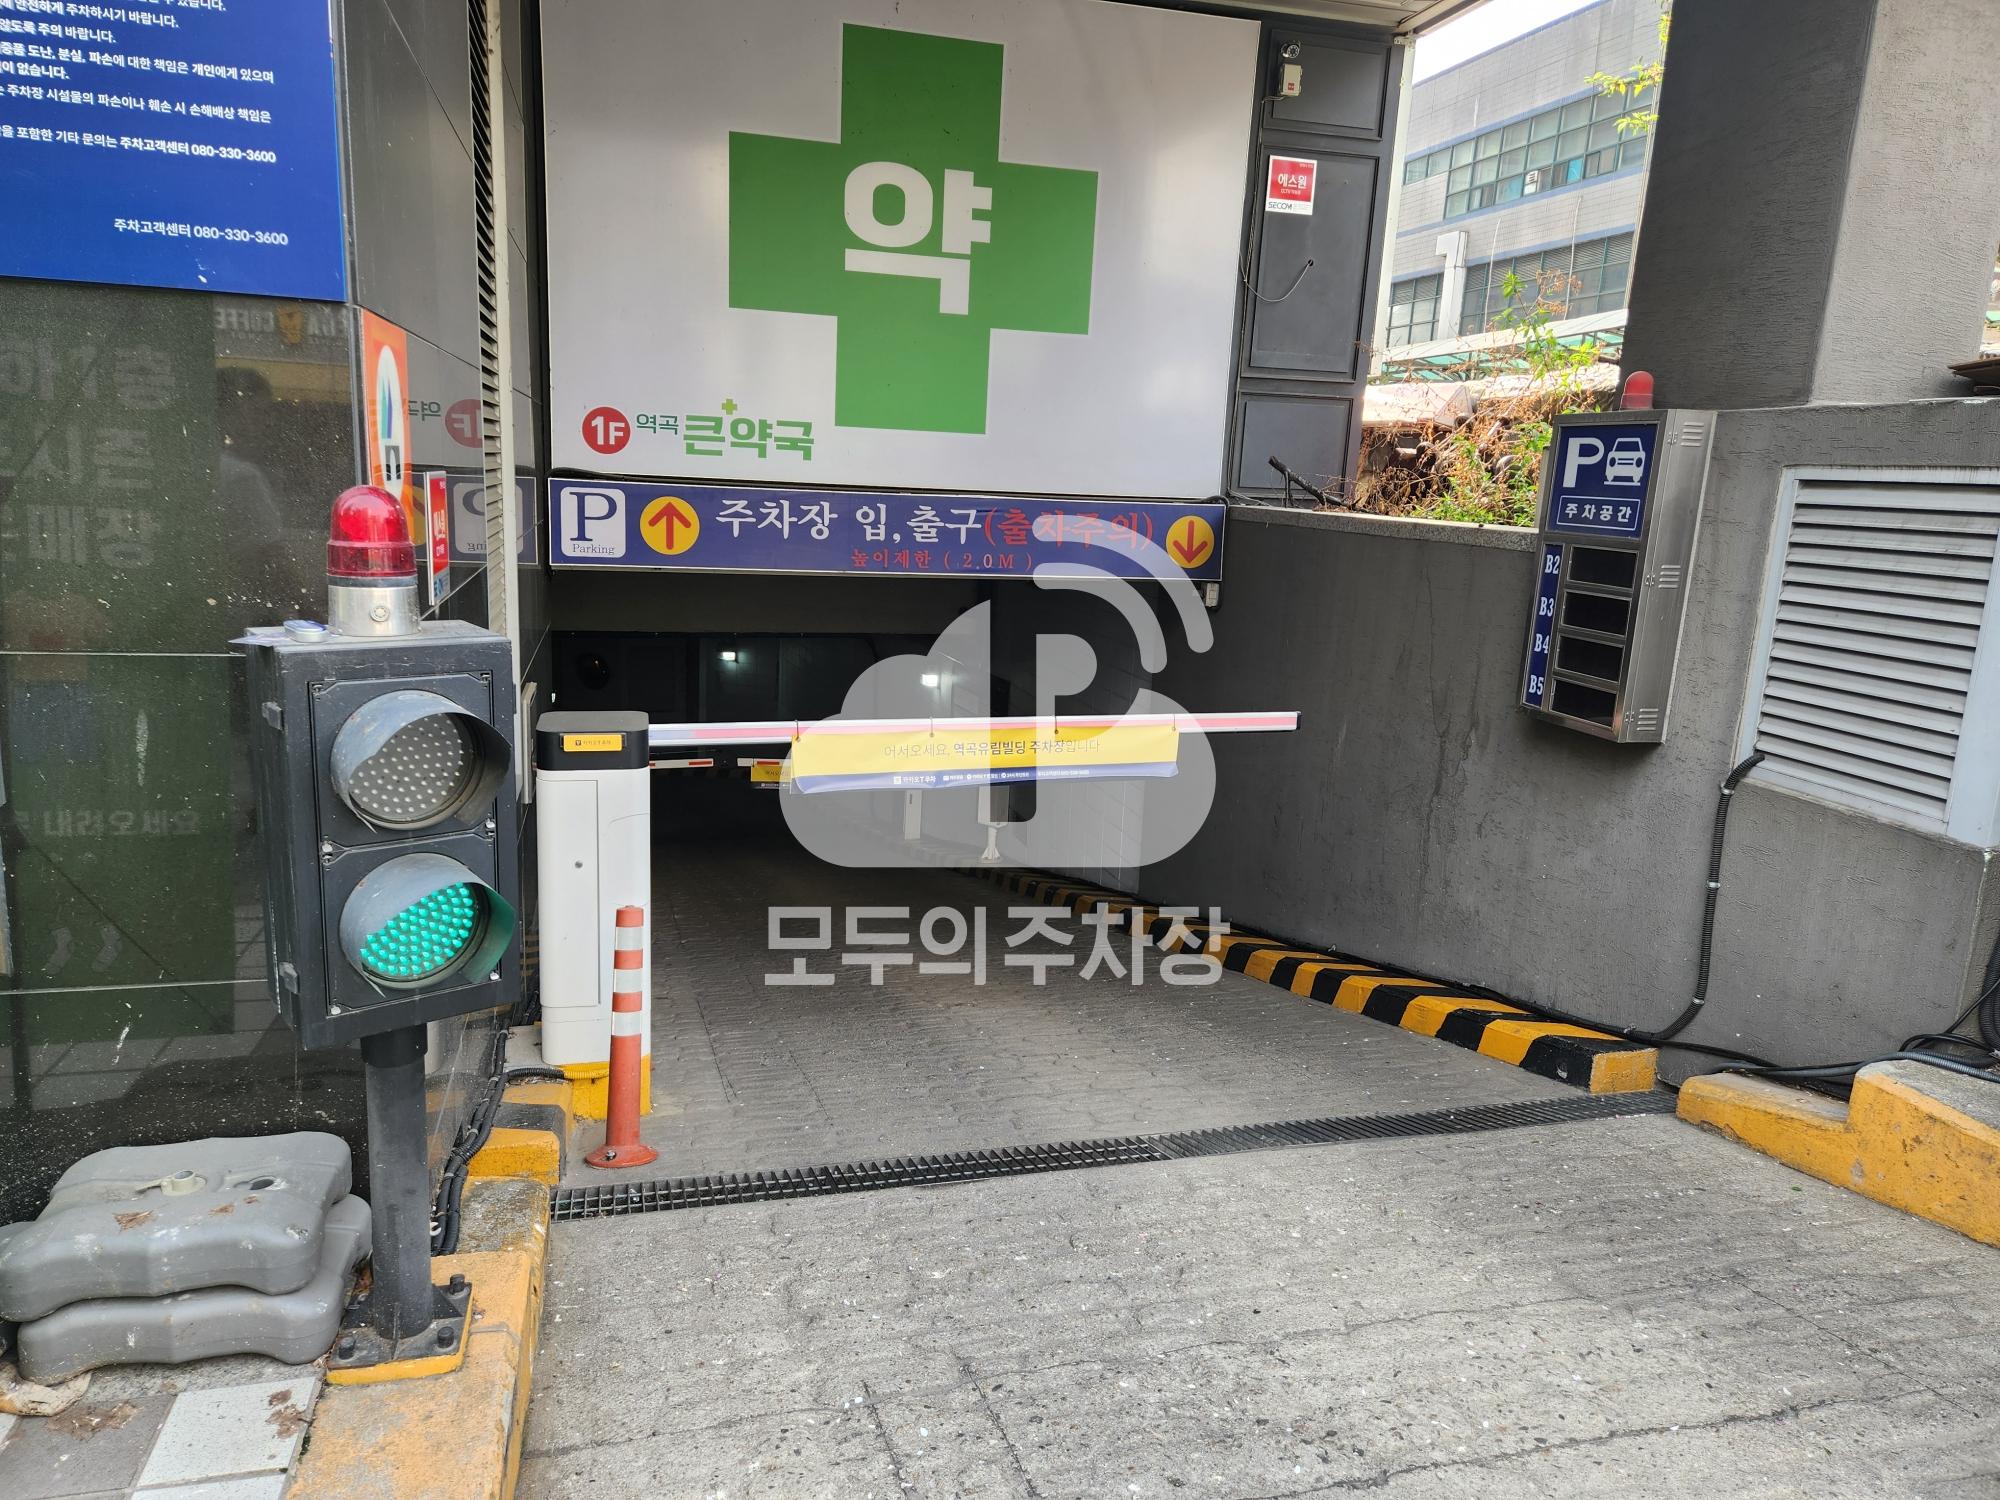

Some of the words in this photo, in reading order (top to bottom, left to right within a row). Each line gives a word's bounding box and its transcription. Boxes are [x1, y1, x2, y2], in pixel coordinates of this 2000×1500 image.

[66, 3, 126, 22] 주차하시기
[128, 10, 179, 28] 바랍니다.
[38, 22, 62, 38] 주의
[65, 26, 116, 43] 바랍니다.
[0, 41, 26, 57] 중품
[88, 51, 125, 68] 파손에
[127, 56, 151, 70] 대한
[153, 58, 189, 75] 책임은
[192, 63, 238, 80] 개인에게
[240, 68, 274, 84] 있으며
[16, 62, 70, 80] 없습니다.
[7, 84, 44, 100] 주차장
[46, 88, 95, 105] 시설물의
[97, 93, 146, 110] 파손이나
[148, 98, 172, 114] 훼손
[174, 102, 186, 115] 시
[189, 103, 235, 120] 손해배상
[237, 108, 272, 124] 책임은
[0, 124, 14, 139] 을
[17, 126, 53, 142] 포함한
[55, 130, 80, 145] 기타
[82, 132, 118, 149] 문의는
[120, 136, 190, 156] 주차고객센터
[191, 143, 277, 164] 080-330-3600
[1278, 173, 1307, 189] 에스원
[1268, 201, 1293, 210] SECOM
[114, 218, 191, 238] 주차고객센터
[193, 225, 289, 246] 080-330-3600
[844, 161, 993, 316] 약
[591, 416, 625, 446] 1F
[636, 413, 679, 435] 역곡
[683, 414, 815, 461] 큰약국
[1562, 437, 1605, 488] P
[569, 491, 618, 542] P
[715, 499, 839, 540] 주차장
[1564, 503, 1632, 524] 주차공간
[572, 543, 615, 556] Parking
[851, 549, 932, 570] 높이제한
[1544, 554, 1561, 575] B2
[1538, 596, 1554, 618] B3
[1534, 633, 1550, 655] B4
[1529, 675, 1544, 696] B5
